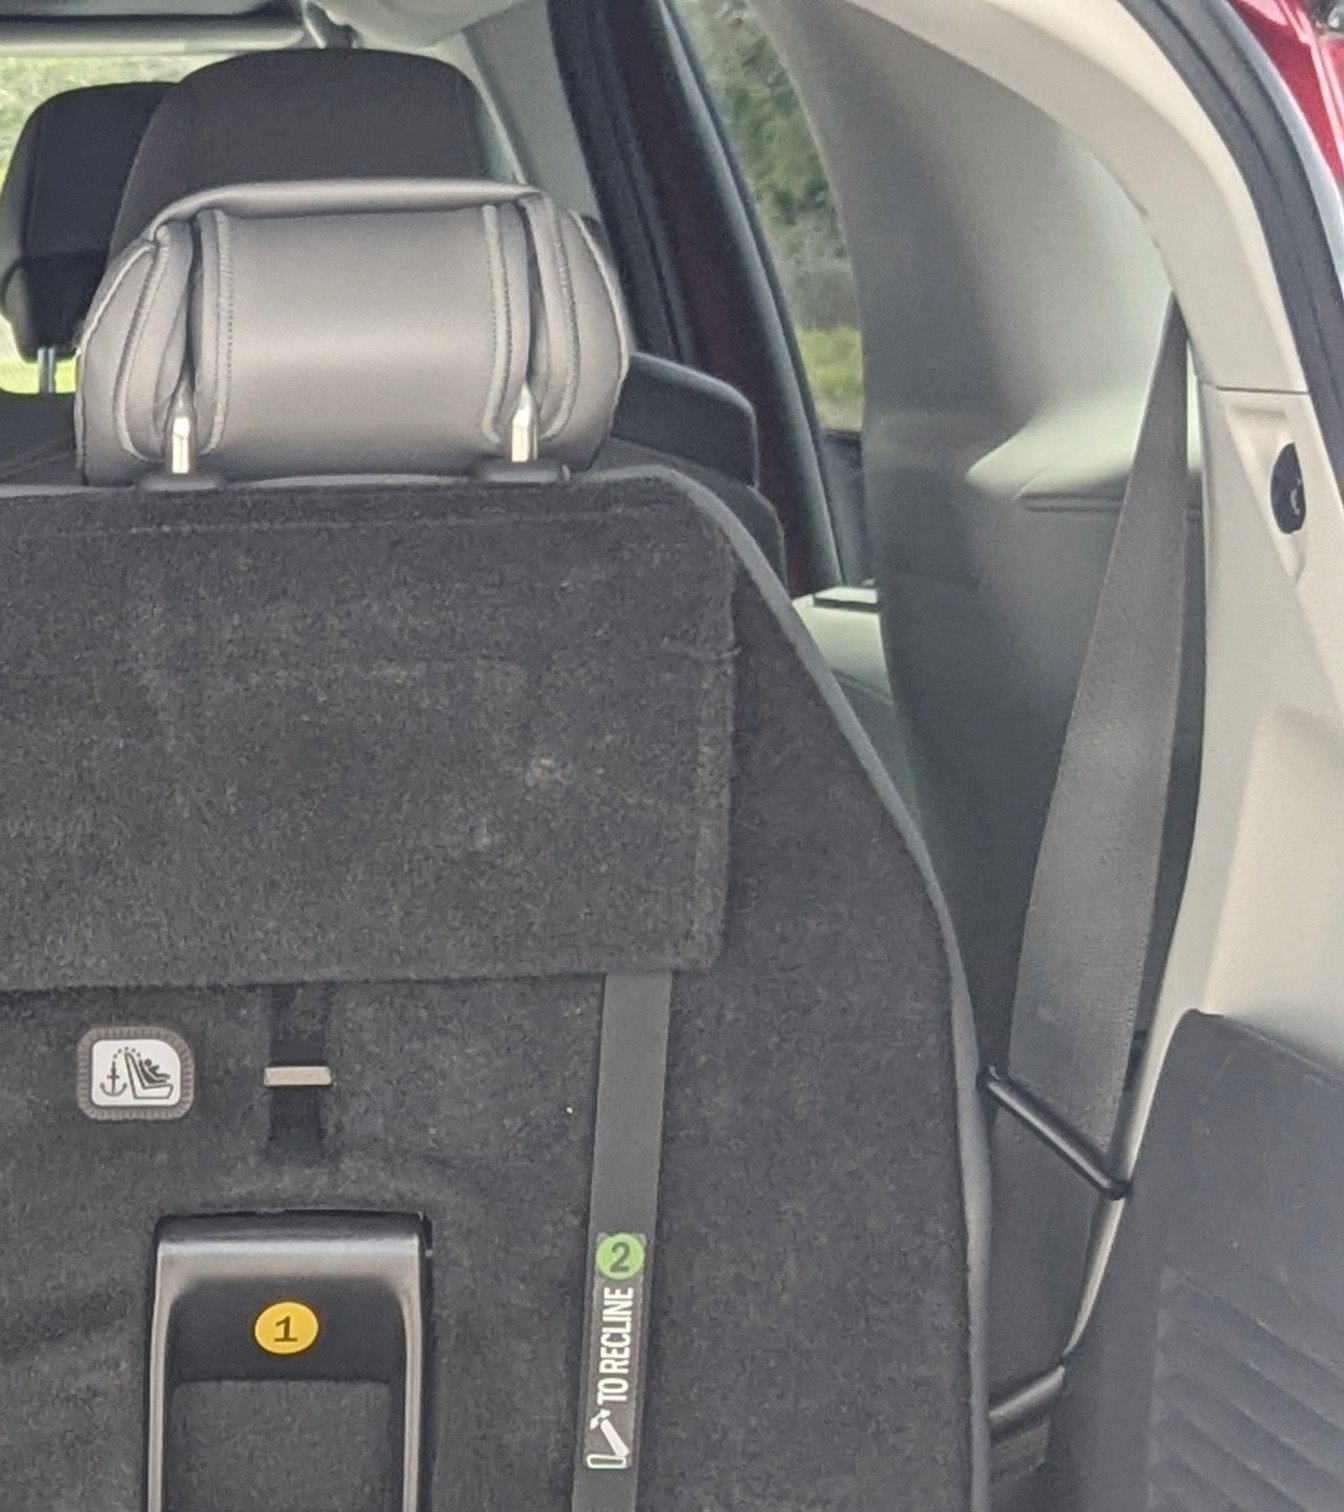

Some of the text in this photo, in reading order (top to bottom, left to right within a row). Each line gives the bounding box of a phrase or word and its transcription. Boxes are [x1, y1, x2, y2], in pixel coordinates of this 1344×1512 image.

[609, 1241, 630, 1273] 2
[273, 1315, 298, 1343] 1
[597, 1287, 634, 1406] TO RECLINE
